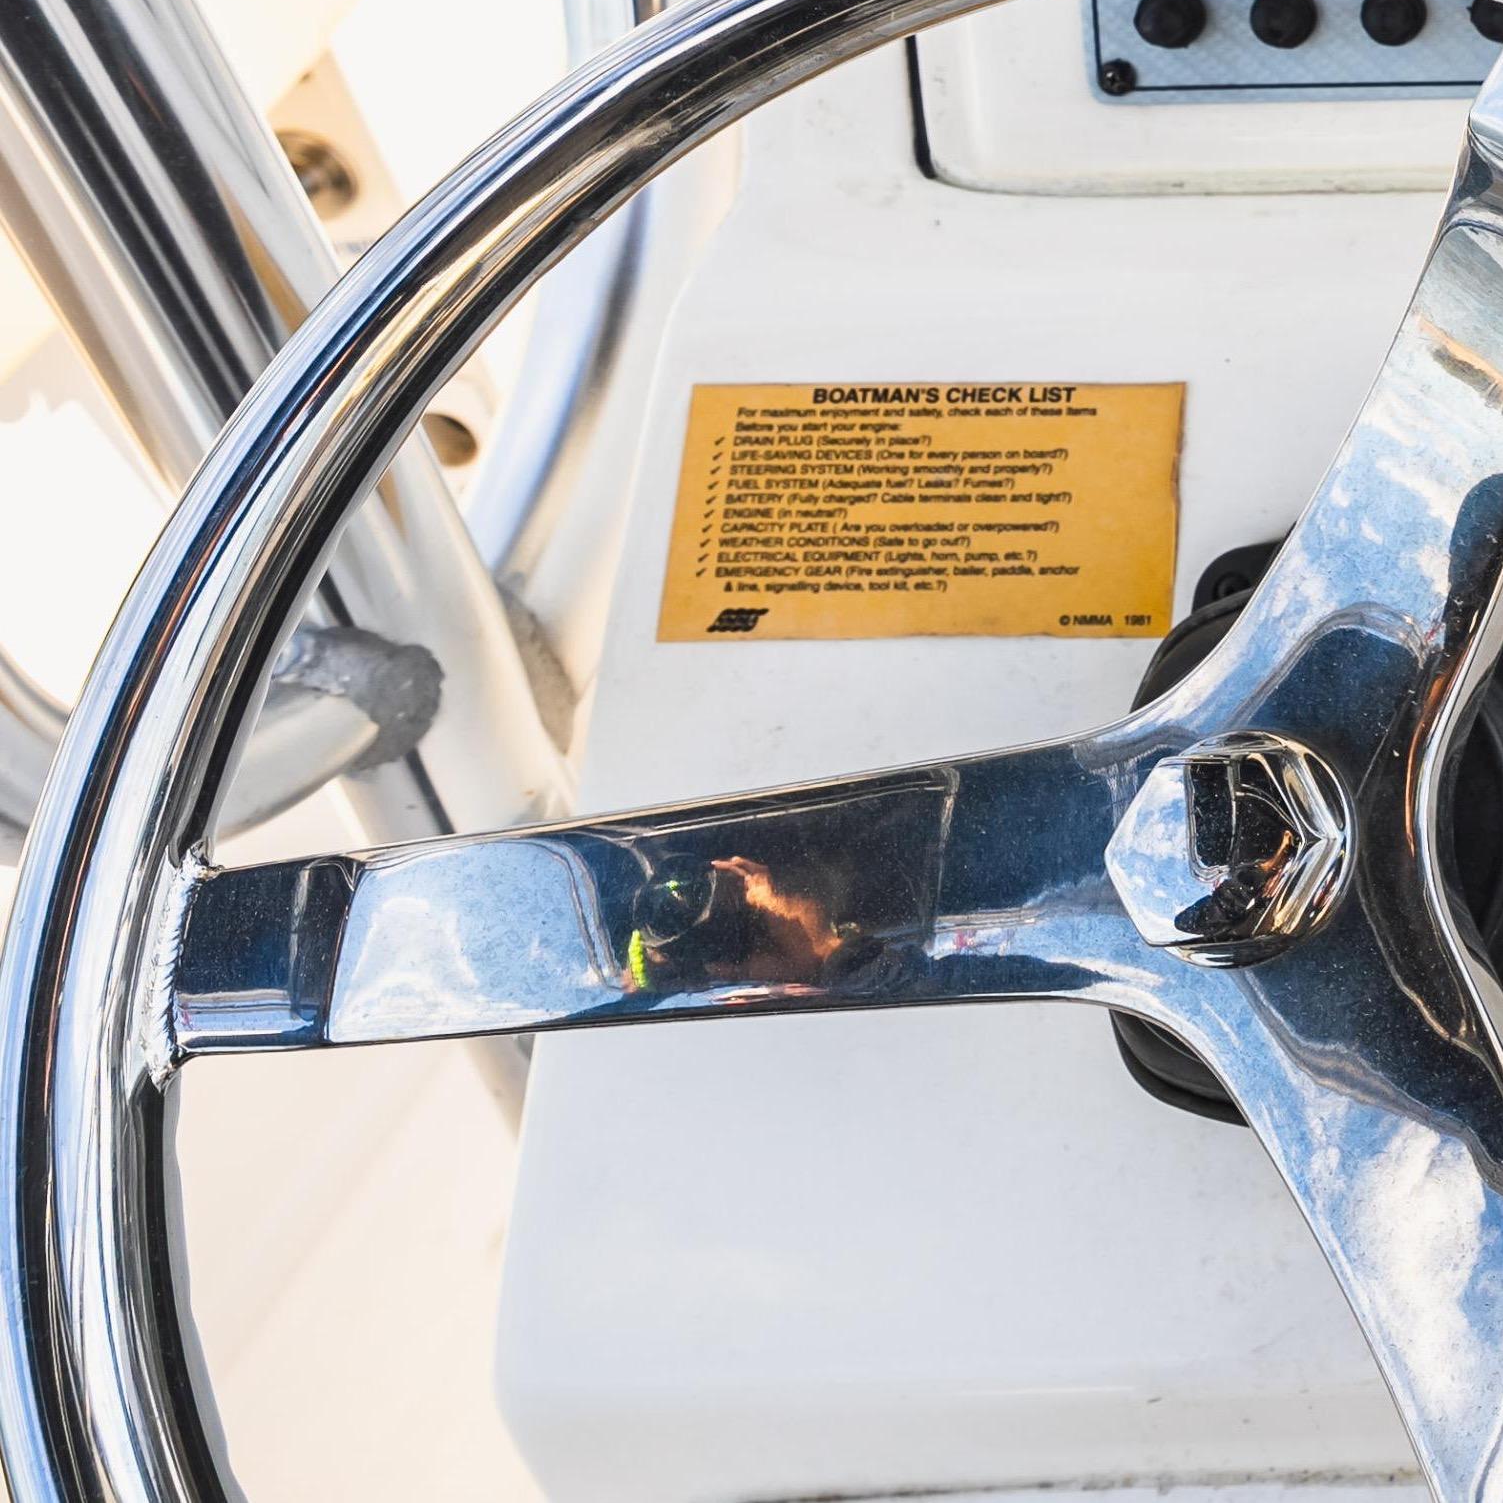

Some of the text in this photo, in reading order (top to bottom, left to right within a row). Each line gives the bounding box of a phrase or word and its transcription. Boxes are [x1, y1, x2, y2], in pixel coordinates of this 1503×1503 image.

[812, 386, 1077, 404] BOATMAN'S CHECK LIST
[737, 407, 757, 417] For
[760, 408, 816, 418] maximum
[819, 407, 880, 419] enjoyment
[883, 407, 905, 417] and
[947, 407, 981, 417] check
[984, 407, 1014, 417] each
[1015, 407, 1029, 416] of
[1030, 407, 1063, 417] these
[735, 421, 774, 432] Before
[776, 423, 799, 434] you
[801, 422, 828, 432] start
[830, 423, 855, 434] your
[733, 435, 932, 448] DRAIN PLUG (Securely in place?)
[731, 448, 1068, 462] LIFE-SAVING DEVICES (One for every person on board?)
[729, 463, 1053, 476] STEERING SYSTEM (Working smoothly and properly?)
[727, 479, 760, 490] FUEL
[764, 479, 819, 489] SYSTEM
[822, 478, 882, 491] (Adequate
[885, 478, 915, 489] fuel?
[725, 493, 785, 505] BATTERY
[787, 493, 820, 506] (Fully
[823, 493, 878, 506] charged?
[881, 492, 915, 503] Cable
[918, 492, 972, 503] terminals
[975, 492, 1007, 503] clean
[1010, 492, 1032, 503] and
[723, 508, 774, 519] ENGINE
[795, 508, 848, 519] neutral?)
[721, 521, 1060, 535] CAPACITY PLATE Are you overloaded or overpowered?)
[718, 536, 971, 549] WEATHER CONDITIONS (Safe to go out?)
[716, 552, 798, 563] ELECTRICAL
[802, 551, 881, 562] EQUIPMENT
[715, 566, 800, 577] EMERGENCY
[804, 566, 842, 577] GEAR
[845, 566, 873, 578] (Fire
[1038, 565, 1080, 576] anchor
[764, 581, 820, 594] signalling
[868, 580, 890, 591] tool
